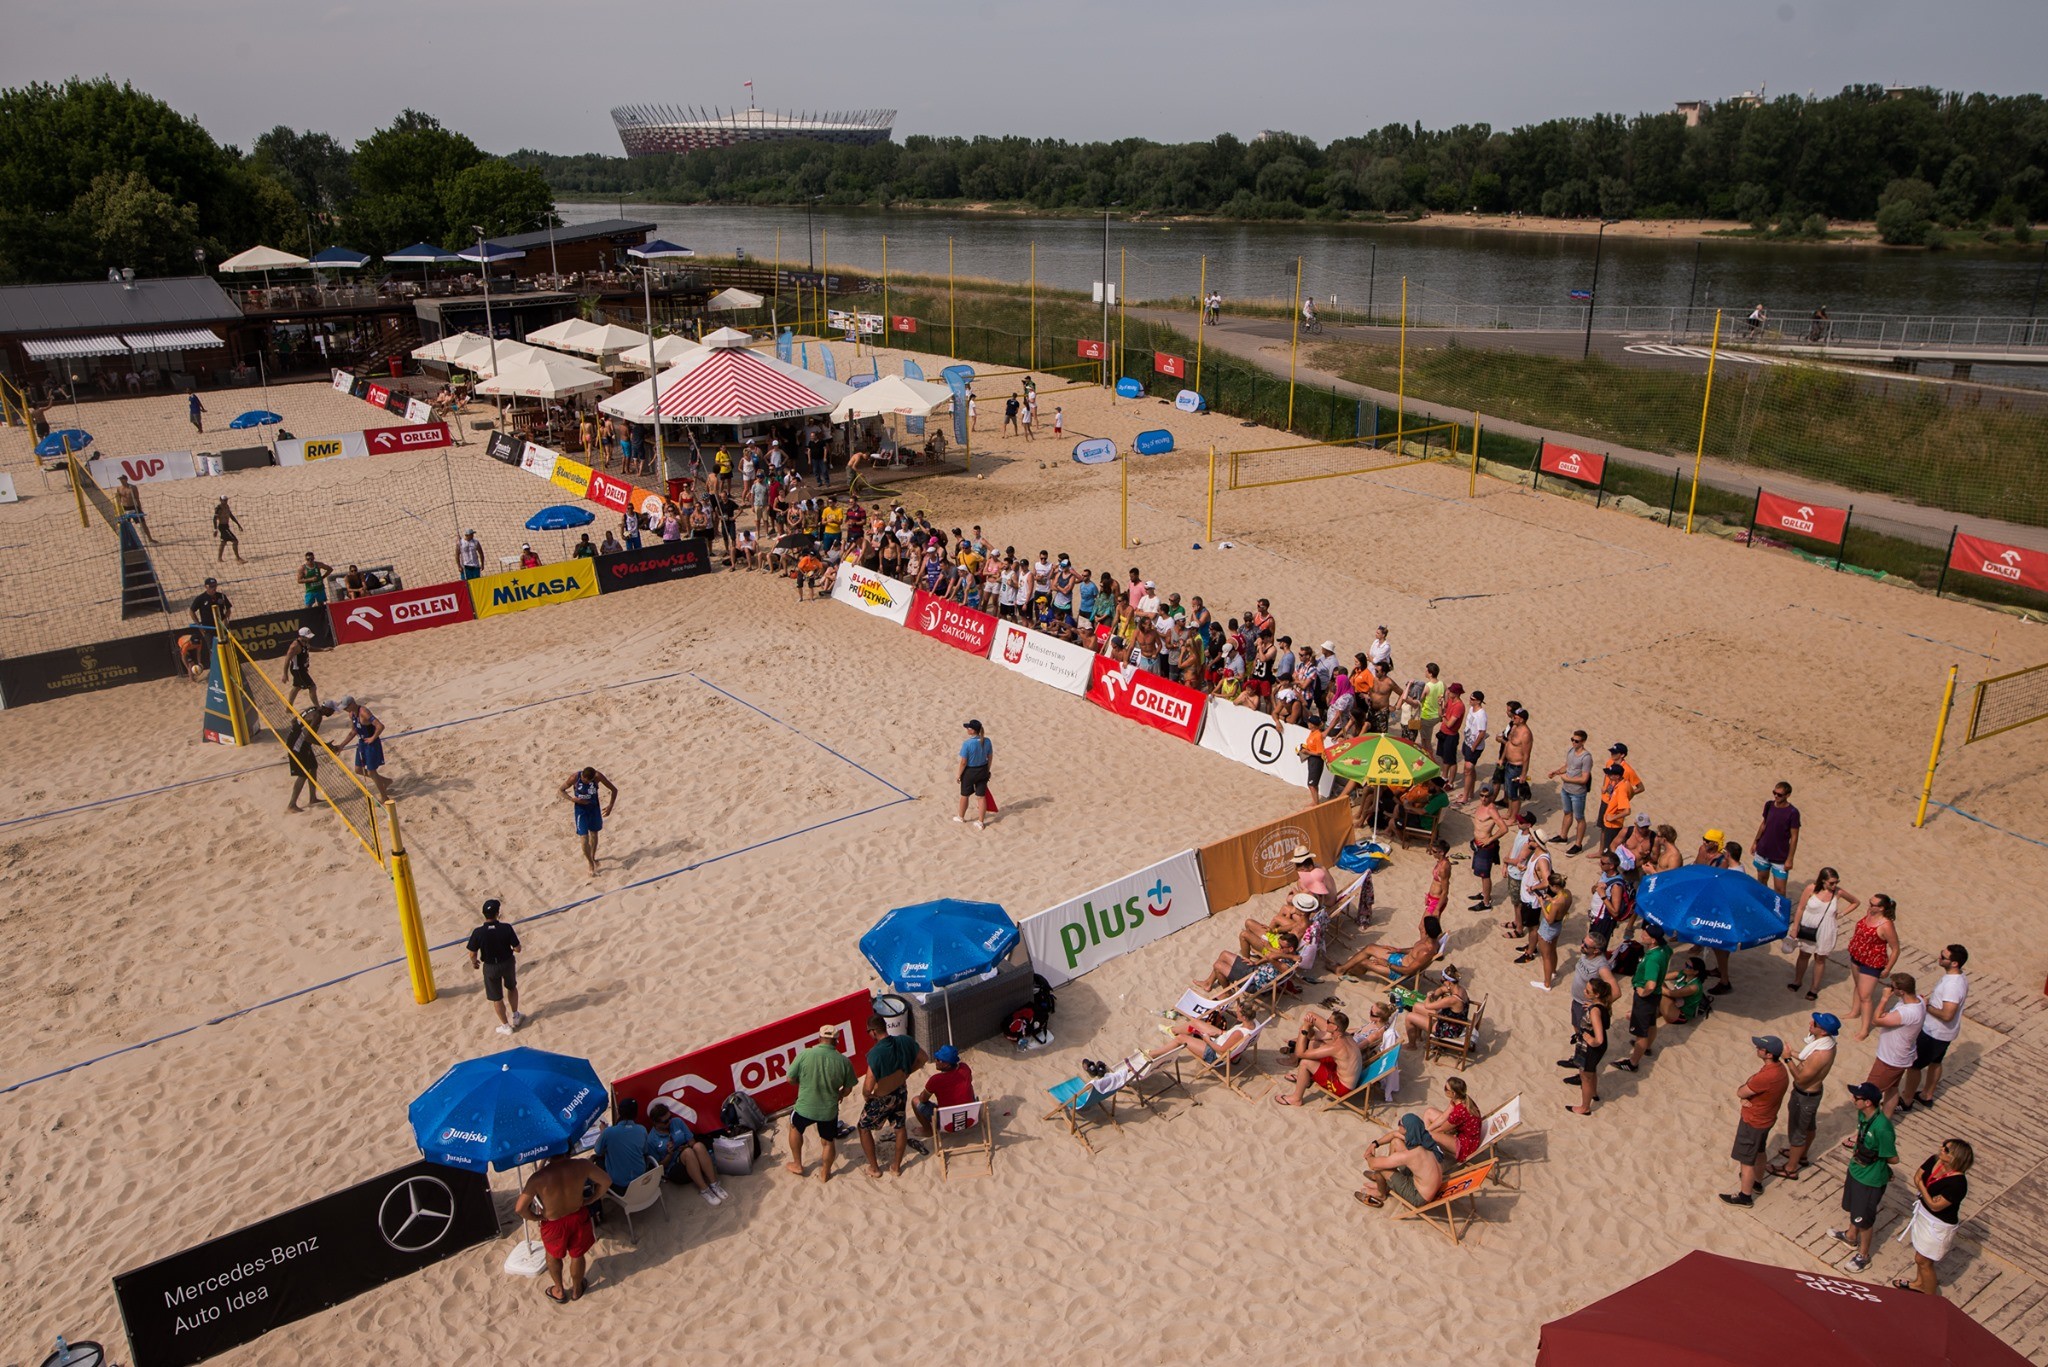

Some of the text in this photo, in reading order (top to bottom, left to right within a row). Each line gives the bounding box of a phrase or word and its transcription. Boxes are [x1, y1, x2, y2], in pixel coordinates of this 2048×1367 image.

[671, 416, 705, 424] MARTINI
[773, 408, 805, 419] MARTINI
[403, 430, 440, 443] ORLEN
[308, 442, 340, 458] RMF
[121, 458, 165, 482] WP
[1783, 518, 1812, 531] ORLEN
[1986, 563, 2018, 578] ORLEN
[492, 576, 580, 607] MIKASA
[852, 572, 881, 591] BLACHY
[849, 583, 893, 609] PRUSZYŃSKI
[395, 597, 454, 620] ORLEN
[232, 619, 300, 641] ARSAW
[944, 610, 985, 635] POLSKA
[941, 623, 981, 647] SIATKÓWKA
[1027, 641, 1066, 661] Ministerstwo
[1025, 654, 1043, 668] Sportu
[1049, 662, 1078, 679] Turystyki
[47, 666, 138, 689] WORLD TOUR
[1136, 689, 1188, 722] ORLEN
[1060, 895, 1145, 970] plus
[1691, 917, 1732, 930] Jurajska
[1698, 935, 1723, 944] Jurajska
[903, 962, 929, 973] Jurajska
[562, 1087, 590, 1120] Jurajska
[442, 1127, 488, 1144] Jurajska
[445, 1153, 472, 1164] Jurajska
[518, 1145, 549, 1161] Jurajska
[164, 1236, 319, 1309] Mercedes-Benz
[175, 1286, 269, 1335] Auto Idea
